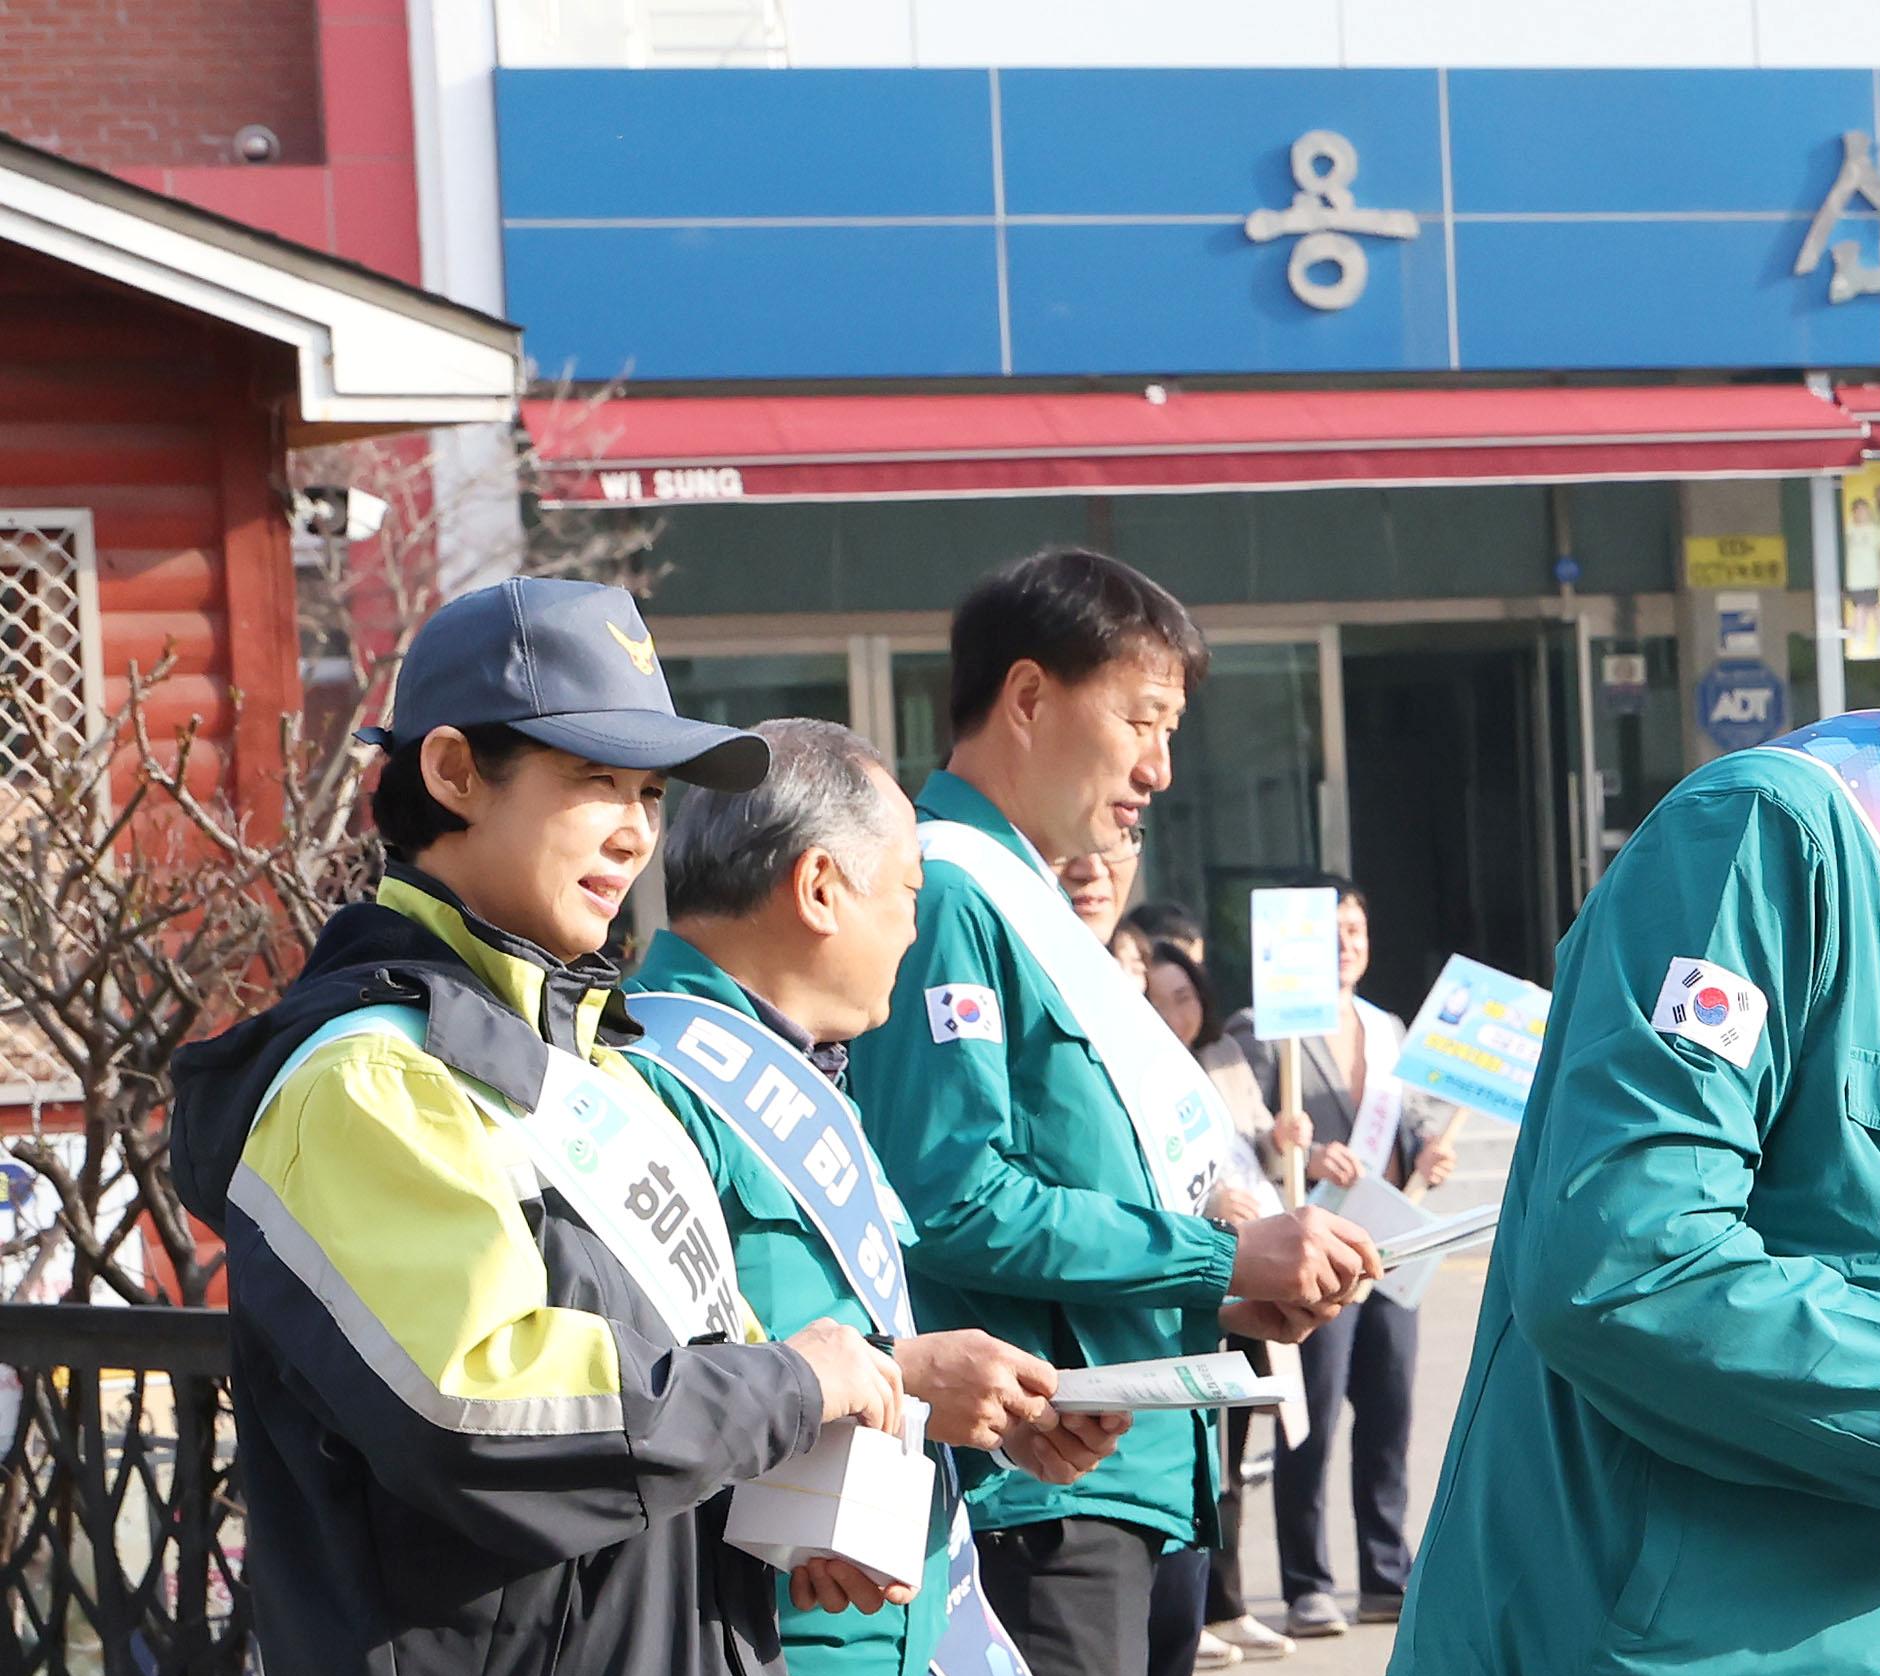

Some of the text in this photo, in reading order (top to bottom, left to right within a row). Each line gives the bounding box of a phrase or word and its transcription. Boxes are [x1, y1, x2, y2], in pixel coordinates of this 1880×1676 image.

[600, 467, 744, 501] WI SUNG
[1710, 687, 1774, 722] ADT
[675, 1016, 860, 1208] 대국민
